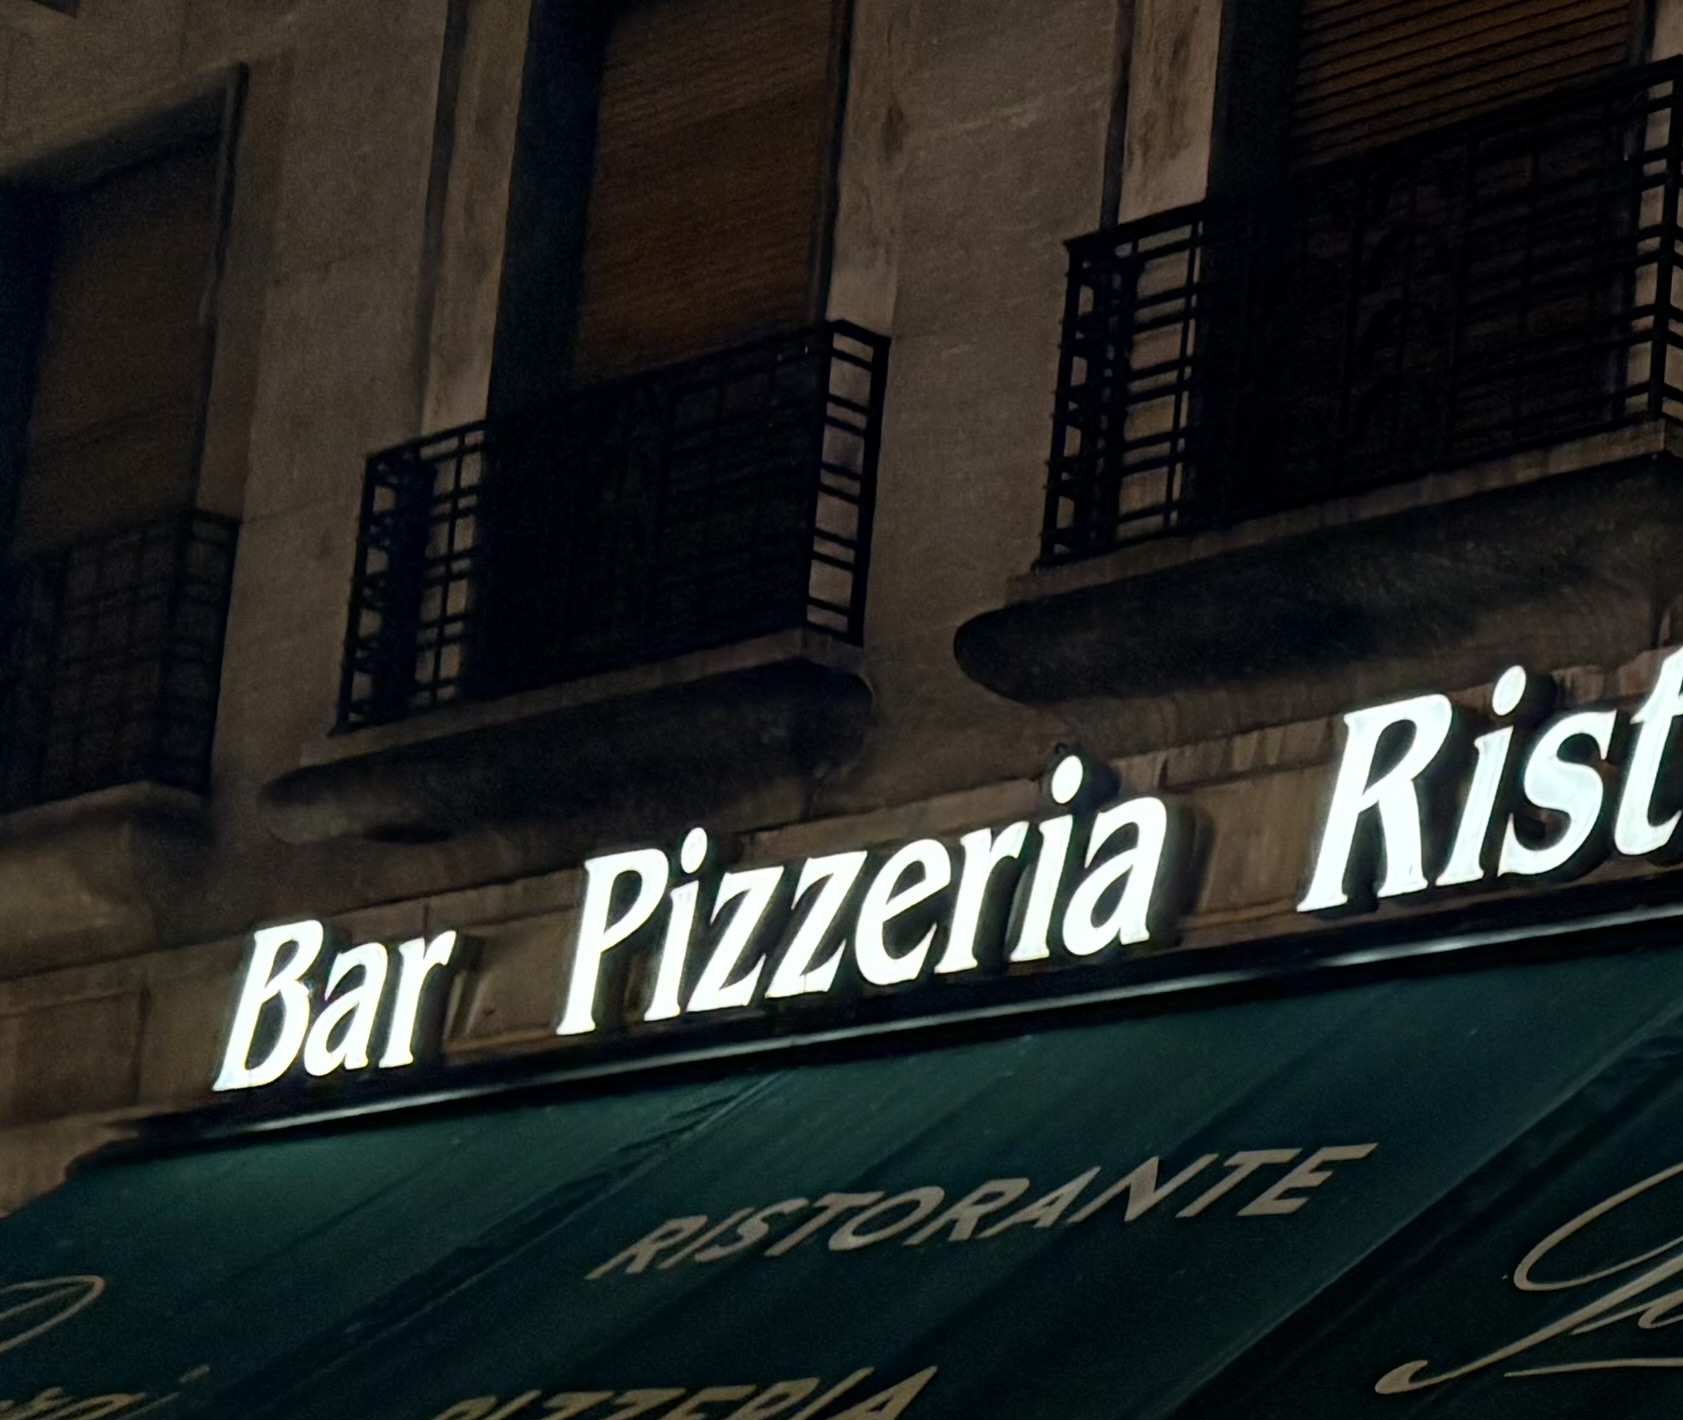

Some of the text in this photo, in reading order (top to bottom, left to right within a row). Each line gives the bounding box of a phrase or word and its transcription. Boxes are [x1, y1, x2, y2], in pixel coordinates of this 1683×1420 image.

[213, 919, 457, 1092] Bar
[556, 754, 1168, 1036] Pizzeria
[584, 1142, 1379, 1281] RISTORANTE
